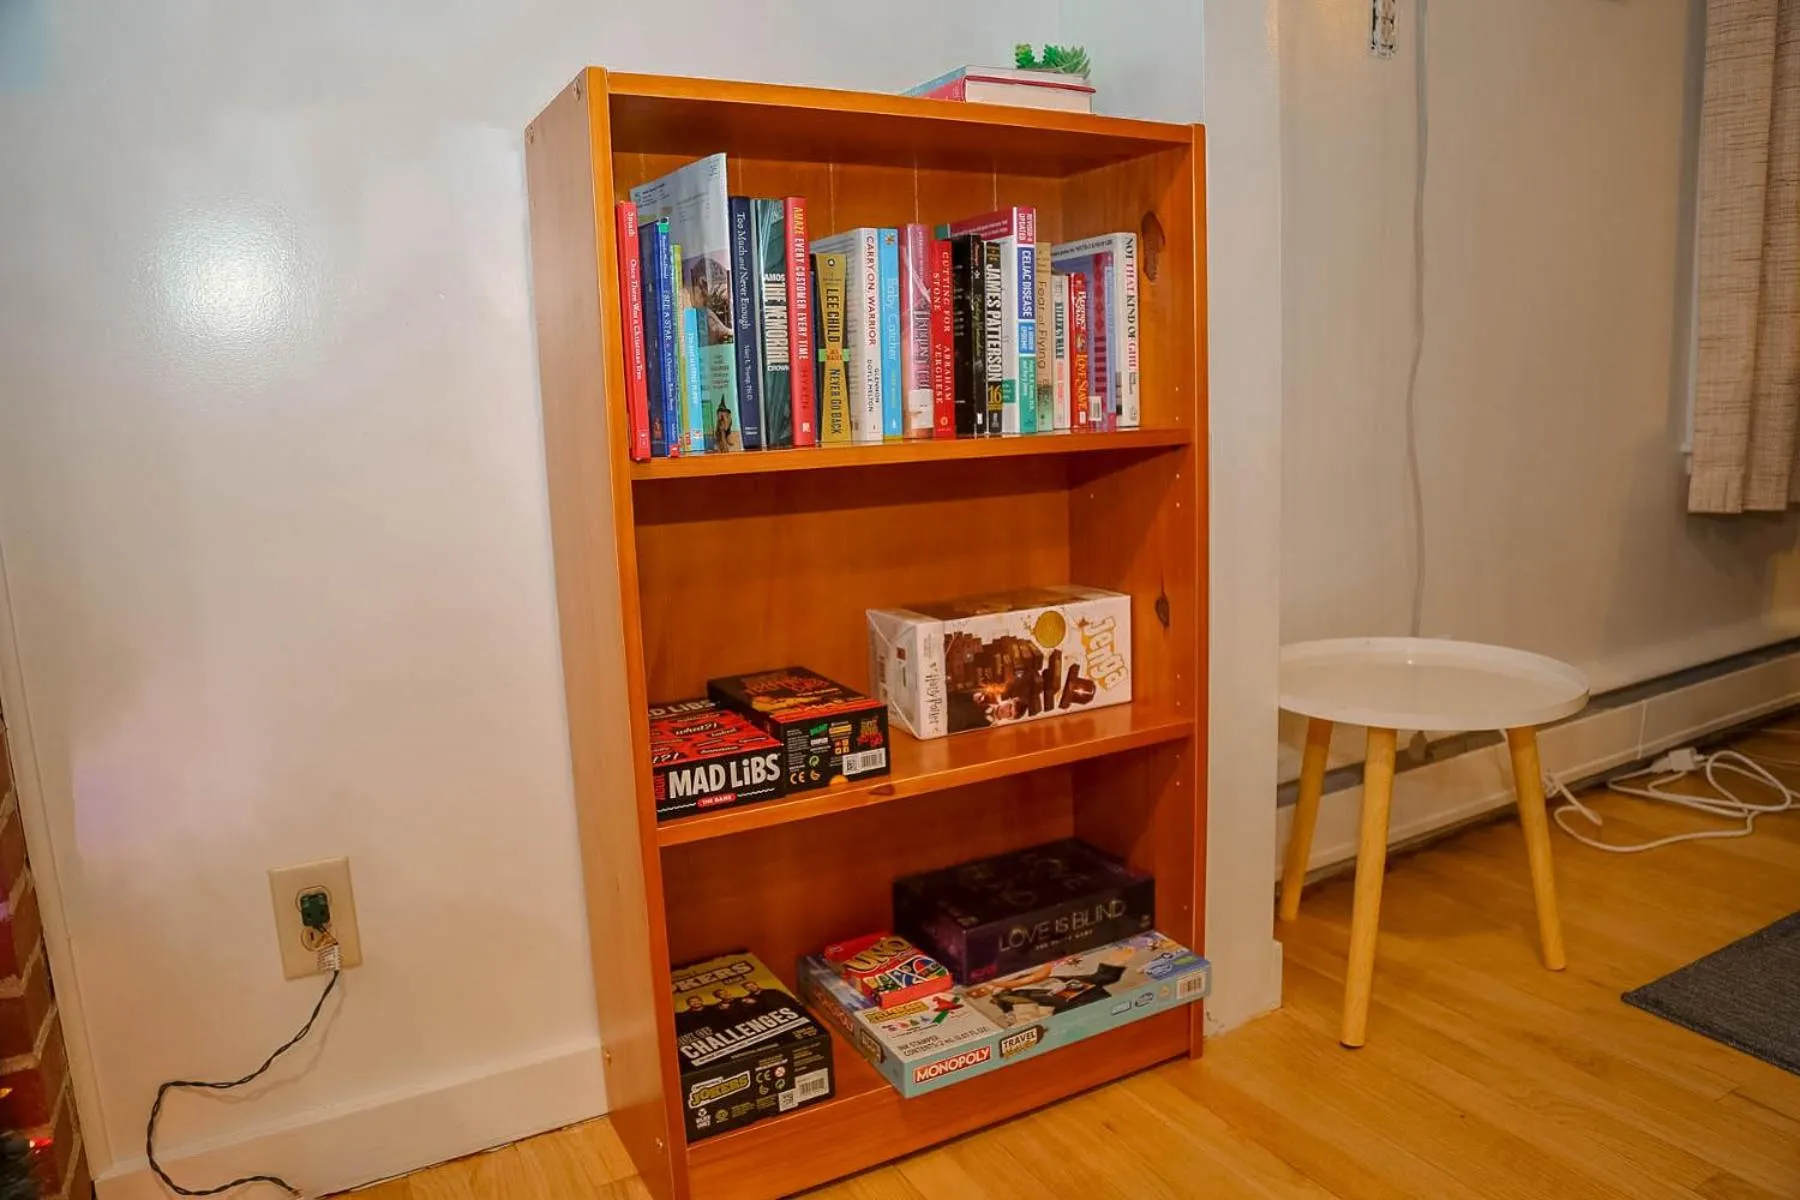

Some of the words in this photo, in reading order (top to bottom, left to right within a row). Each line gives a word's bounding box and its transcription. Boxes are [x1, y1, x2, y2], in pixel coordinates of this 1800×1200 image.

[736, 212, 746, 229] Too
[793, 207, 804, 235] AMAZE
[1018, 213, 1026, 241] UPDATED
[738, 230, 748, 254] Much
[795, 238, 805, 262] EVERY
[866, 235, 876, 270] CARRY
[1125, 237, 1134, 259] NOT
[942, 251, 950, 304] CUTTING
[1021, 250, 1031, 280] CELIAC
[1126, 263, 1134, 293] THAT
[631, 280, 639, 302] There
[740, 270, 749, 296] Never
[765, 282, 787, 302] THE
[796, 266, 806, 309] CUSTOMER
[826, 288, 840, 308] LEE
[867, 273, 876, 293] ON,
[886, 278, 898, 309] Baby
[933, 272, 941, 310] STONE
[985, 264, 1001, 308] JAMES
[1038, 281, 1047, 311] Fear
[740, 297, 751, 330] Enough
[1022, 281, 1032, 317] DISEASE
[1127, 294, 1136, 323] KIND
[664, 320, 672, 341] STAR
[765, 305, 790, 365] MEMORIAL
[797, 312, 808, 337] EVERY
[827, 311, 841, 342] CHILD
[868, 296, 877, 345] WARRIOR
[943, 310, 951, 332] FOR
[1127, 326, 1136, 340] OF
[798, 340, 809, 360] TIME
[888, 313, 900, 361] Catcher
[985, 310, 1002, 382] PATTERSON
[1037, 330, 1048, 369] Flying
[1077, 354, 1089, 378] LOVE
[1128, 342, 1136, 367] GIRL
[829, 368, 841, 396] NEVER
[935, 343, 943, 404] VERGHESE
[944, 345, 952, 401] ABRAHAM
[831, 400, 842, 411] GO
[988, 385, 1002, 404] 16
[1074, 379, 1088, 410] SLAVE
[831, 412, 842, 434] BACK
[1082, 615, 1128, 690] Jenga
[924, 672, 941, 699] Harry
[927, 699, 942, 726] Potter
[668, 763, 726, 799] MAD
[714, 794, 733, 803] GAME
[998, 919, 1051, 952] LOVE
[1055, 916, 1070, 934] IS
[1071, 898, 1127, 931] BLIND
[845, 937, 913, 970] UNO
[674, 961, 752, 992] KERS
[680, 1006, 800, 1060] CHALLENGES
[1003, 1031, 1037, 1049] TRAVEL
[915, 1046, 990, 1083] MONOPOLY
[692, 1073, 749, 1107] JOKERS
